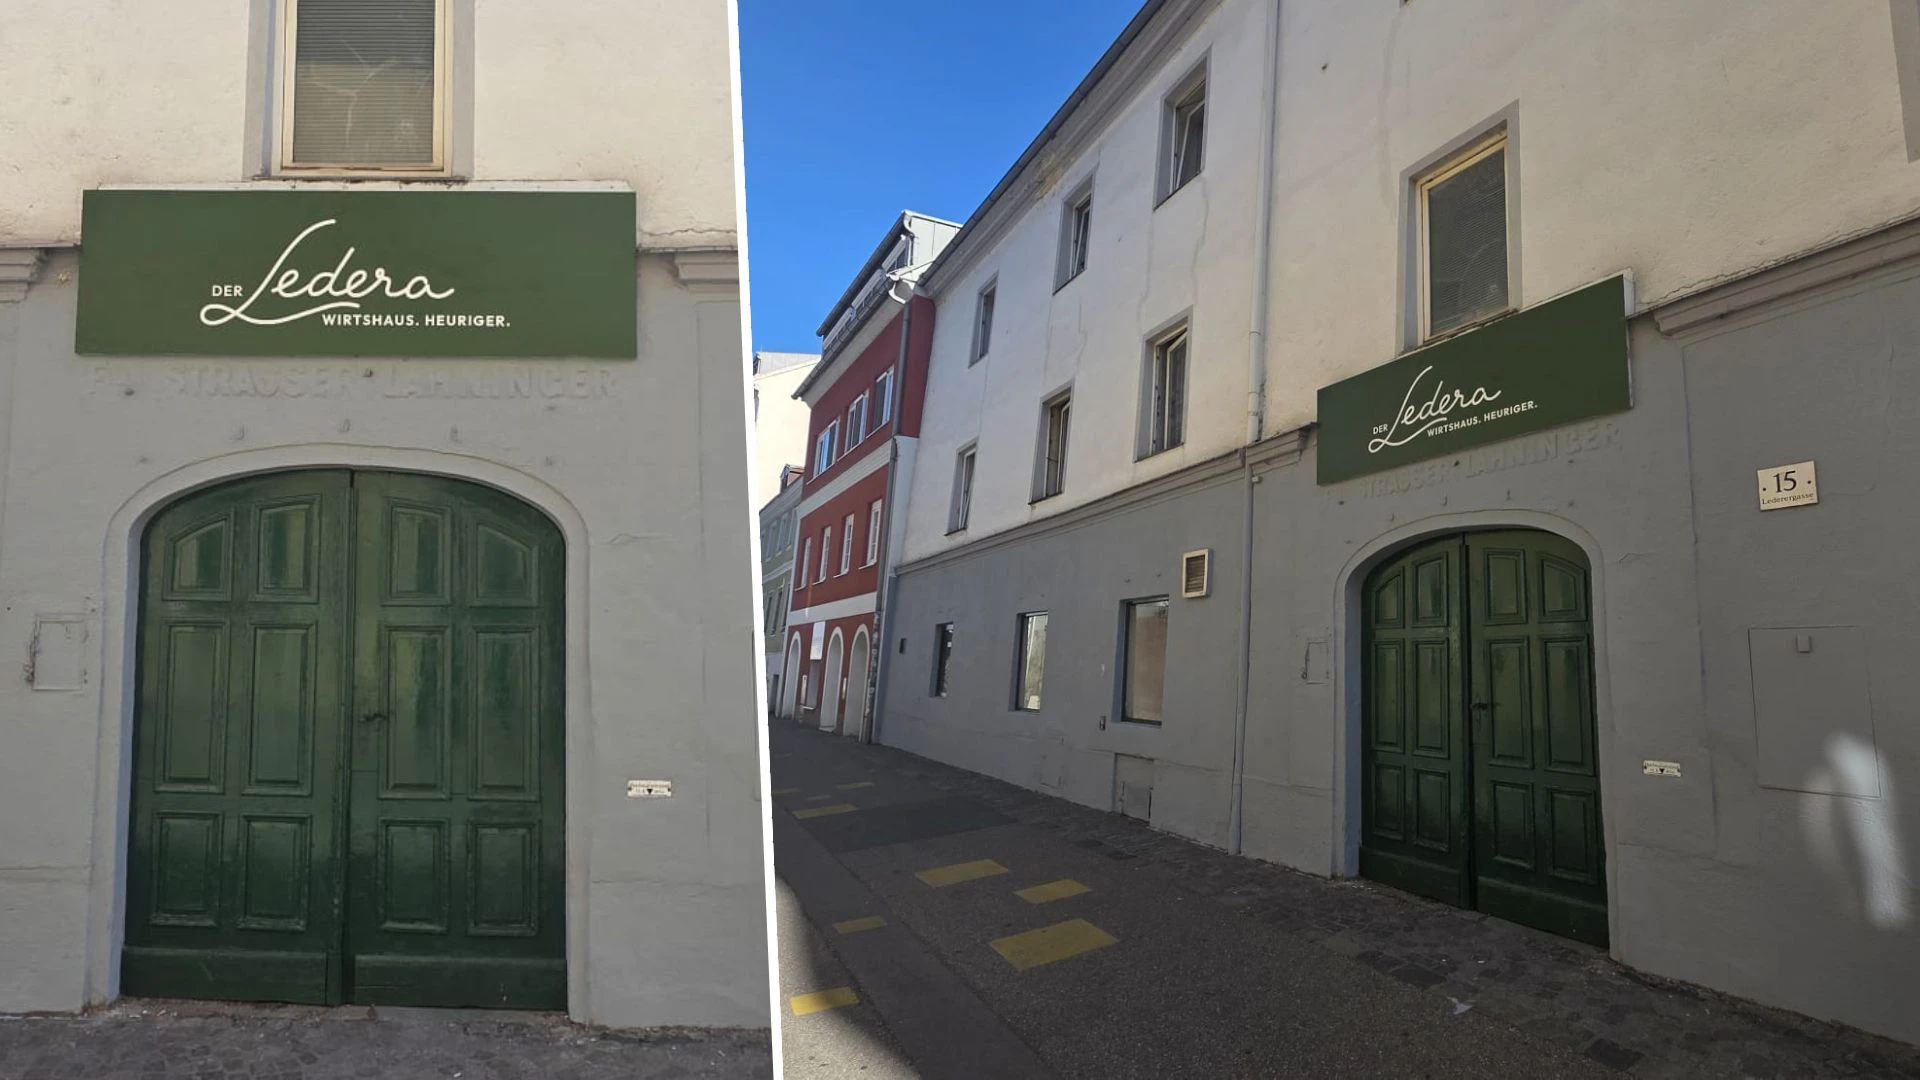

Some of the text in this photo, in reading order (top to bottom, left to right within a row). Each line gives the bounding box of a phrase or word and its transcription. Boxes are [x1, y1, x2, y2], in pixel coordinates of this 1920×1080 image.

[200, 218, 455, 326] DER Ledera
[321, 313, 511, 328] WIRTSHAUS. HEURIGER.
[1368, 365, 1502, 453] DER Ledera
[1426, 400, 1538, 437] WIRTSHAUS. HEURIGER.
[1773, 470, 1797, 493] 15
[1762, 493, 1814, 505] Lederergasse
